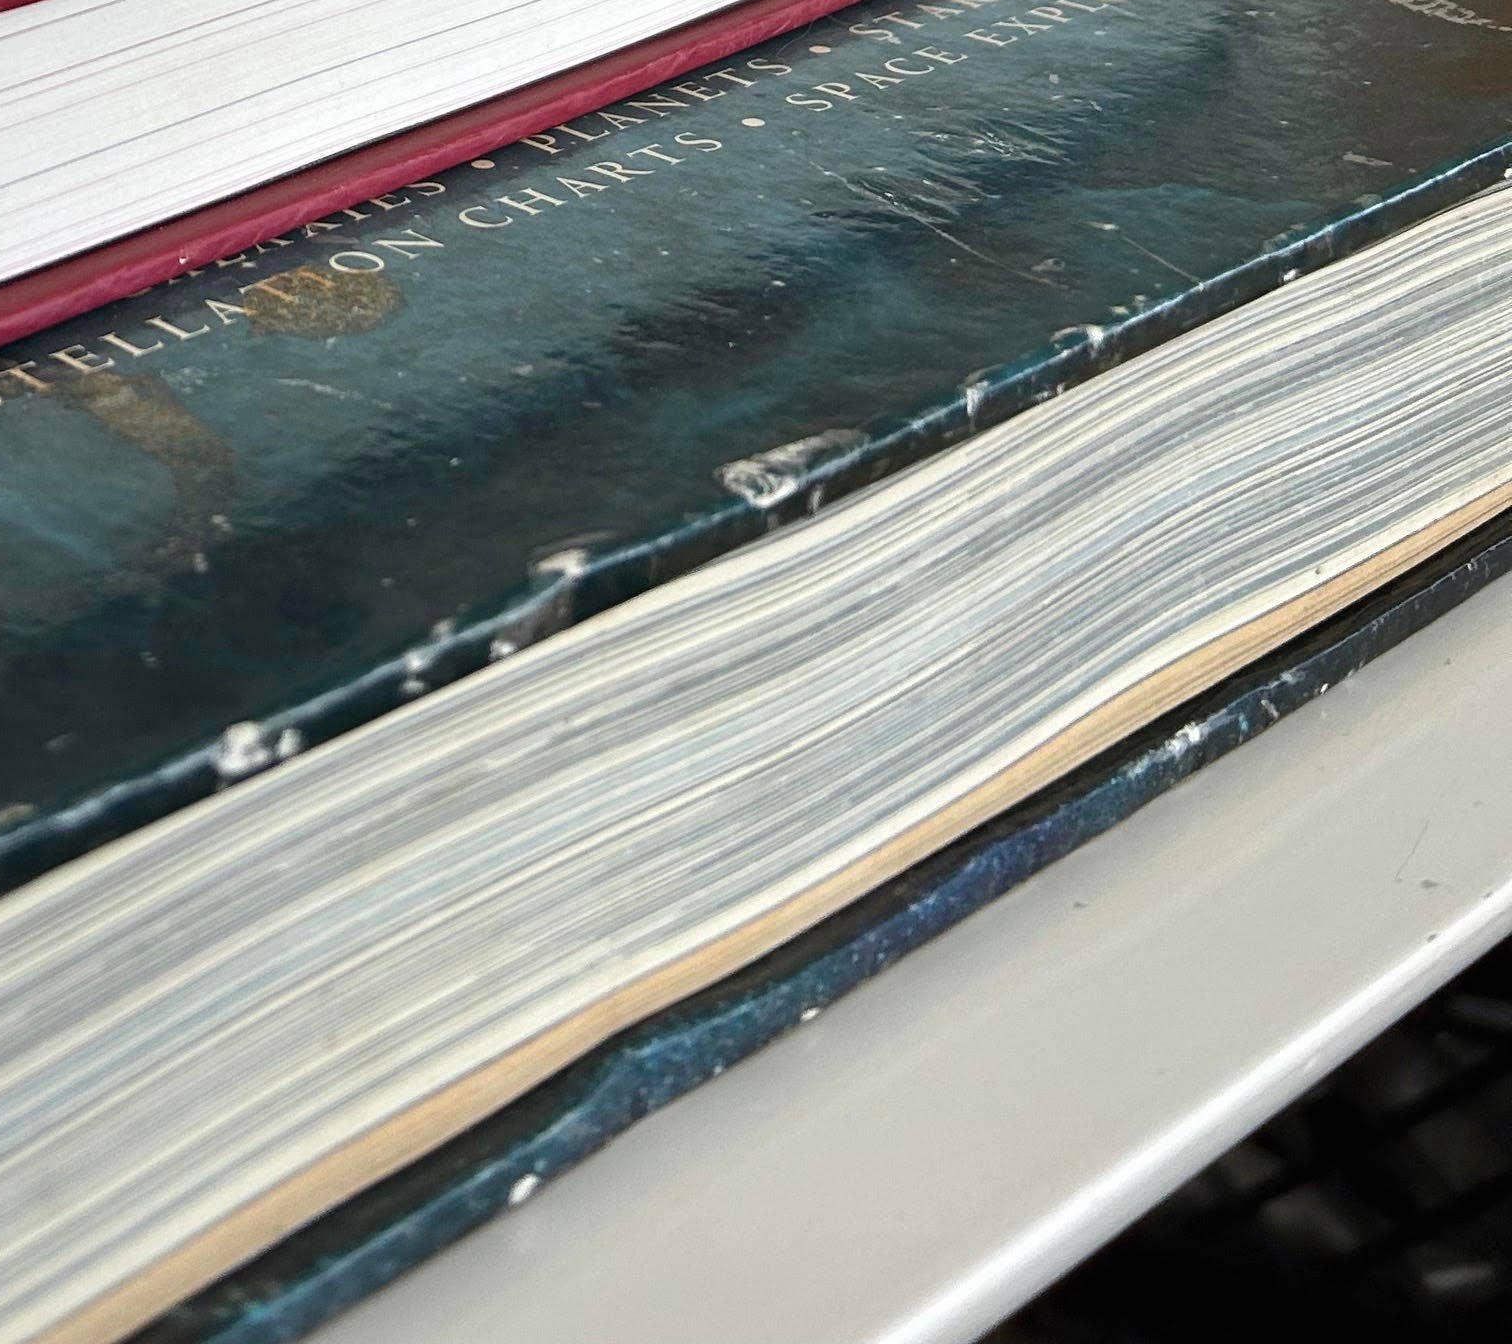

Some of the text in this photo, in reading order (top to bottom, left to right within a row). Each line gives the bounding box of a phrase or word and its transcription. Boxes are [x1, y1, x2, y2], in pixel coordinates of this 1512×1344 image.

[458, 131, 722, 230] CHARTS
[785, 44, 968, 112] SPACE
[520, 57, 792, 155] PLANETS
